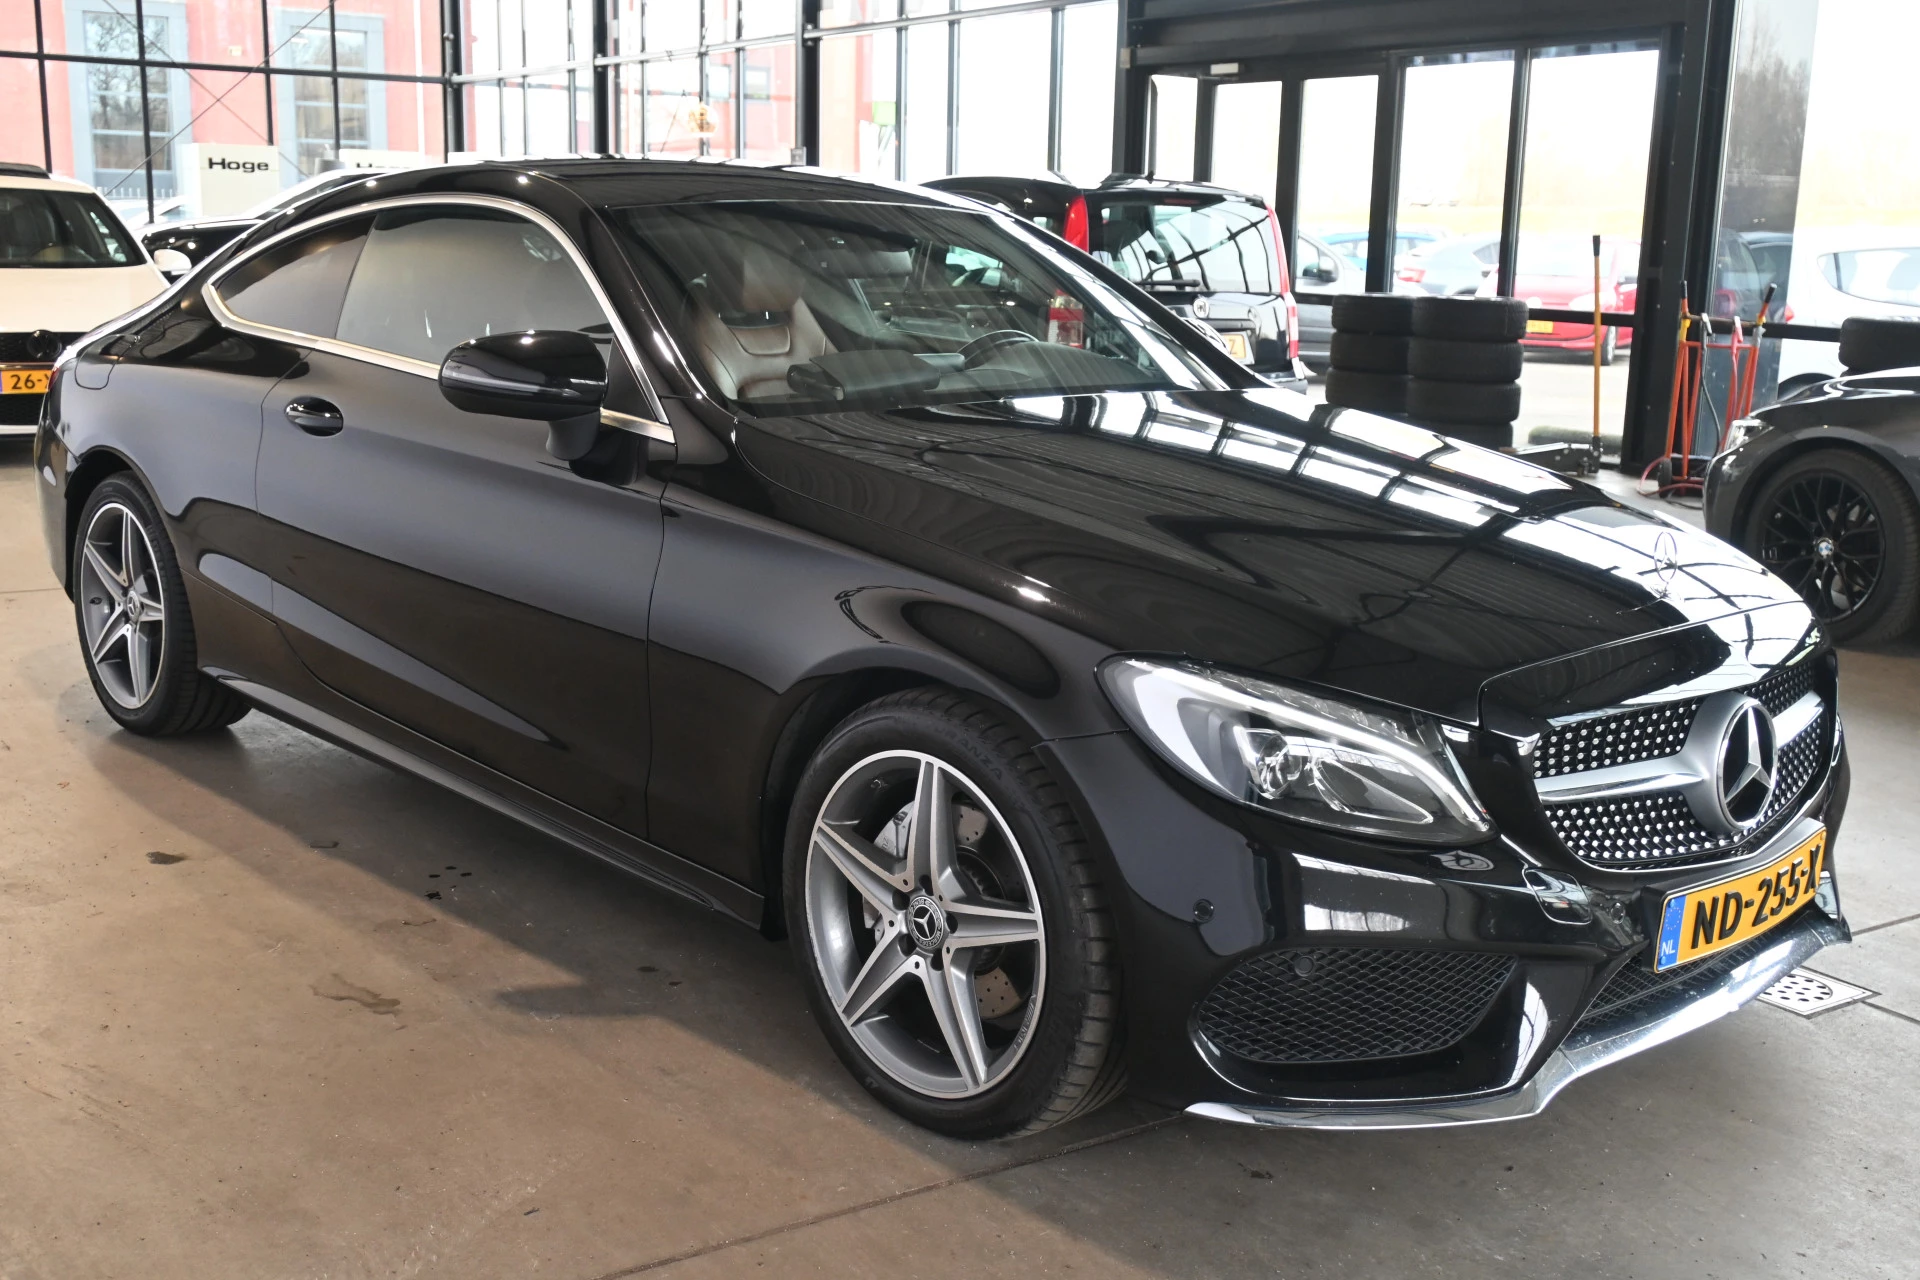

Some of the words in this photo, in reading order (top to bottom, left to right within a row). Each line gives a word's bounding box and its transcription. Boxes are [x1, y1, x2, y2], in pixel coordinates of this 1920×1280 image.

[208, 157, 269, 173] Hoge
[1691, 843, 1822, 950] ND-255-X
[1660, 939, 1676, 955] NL
